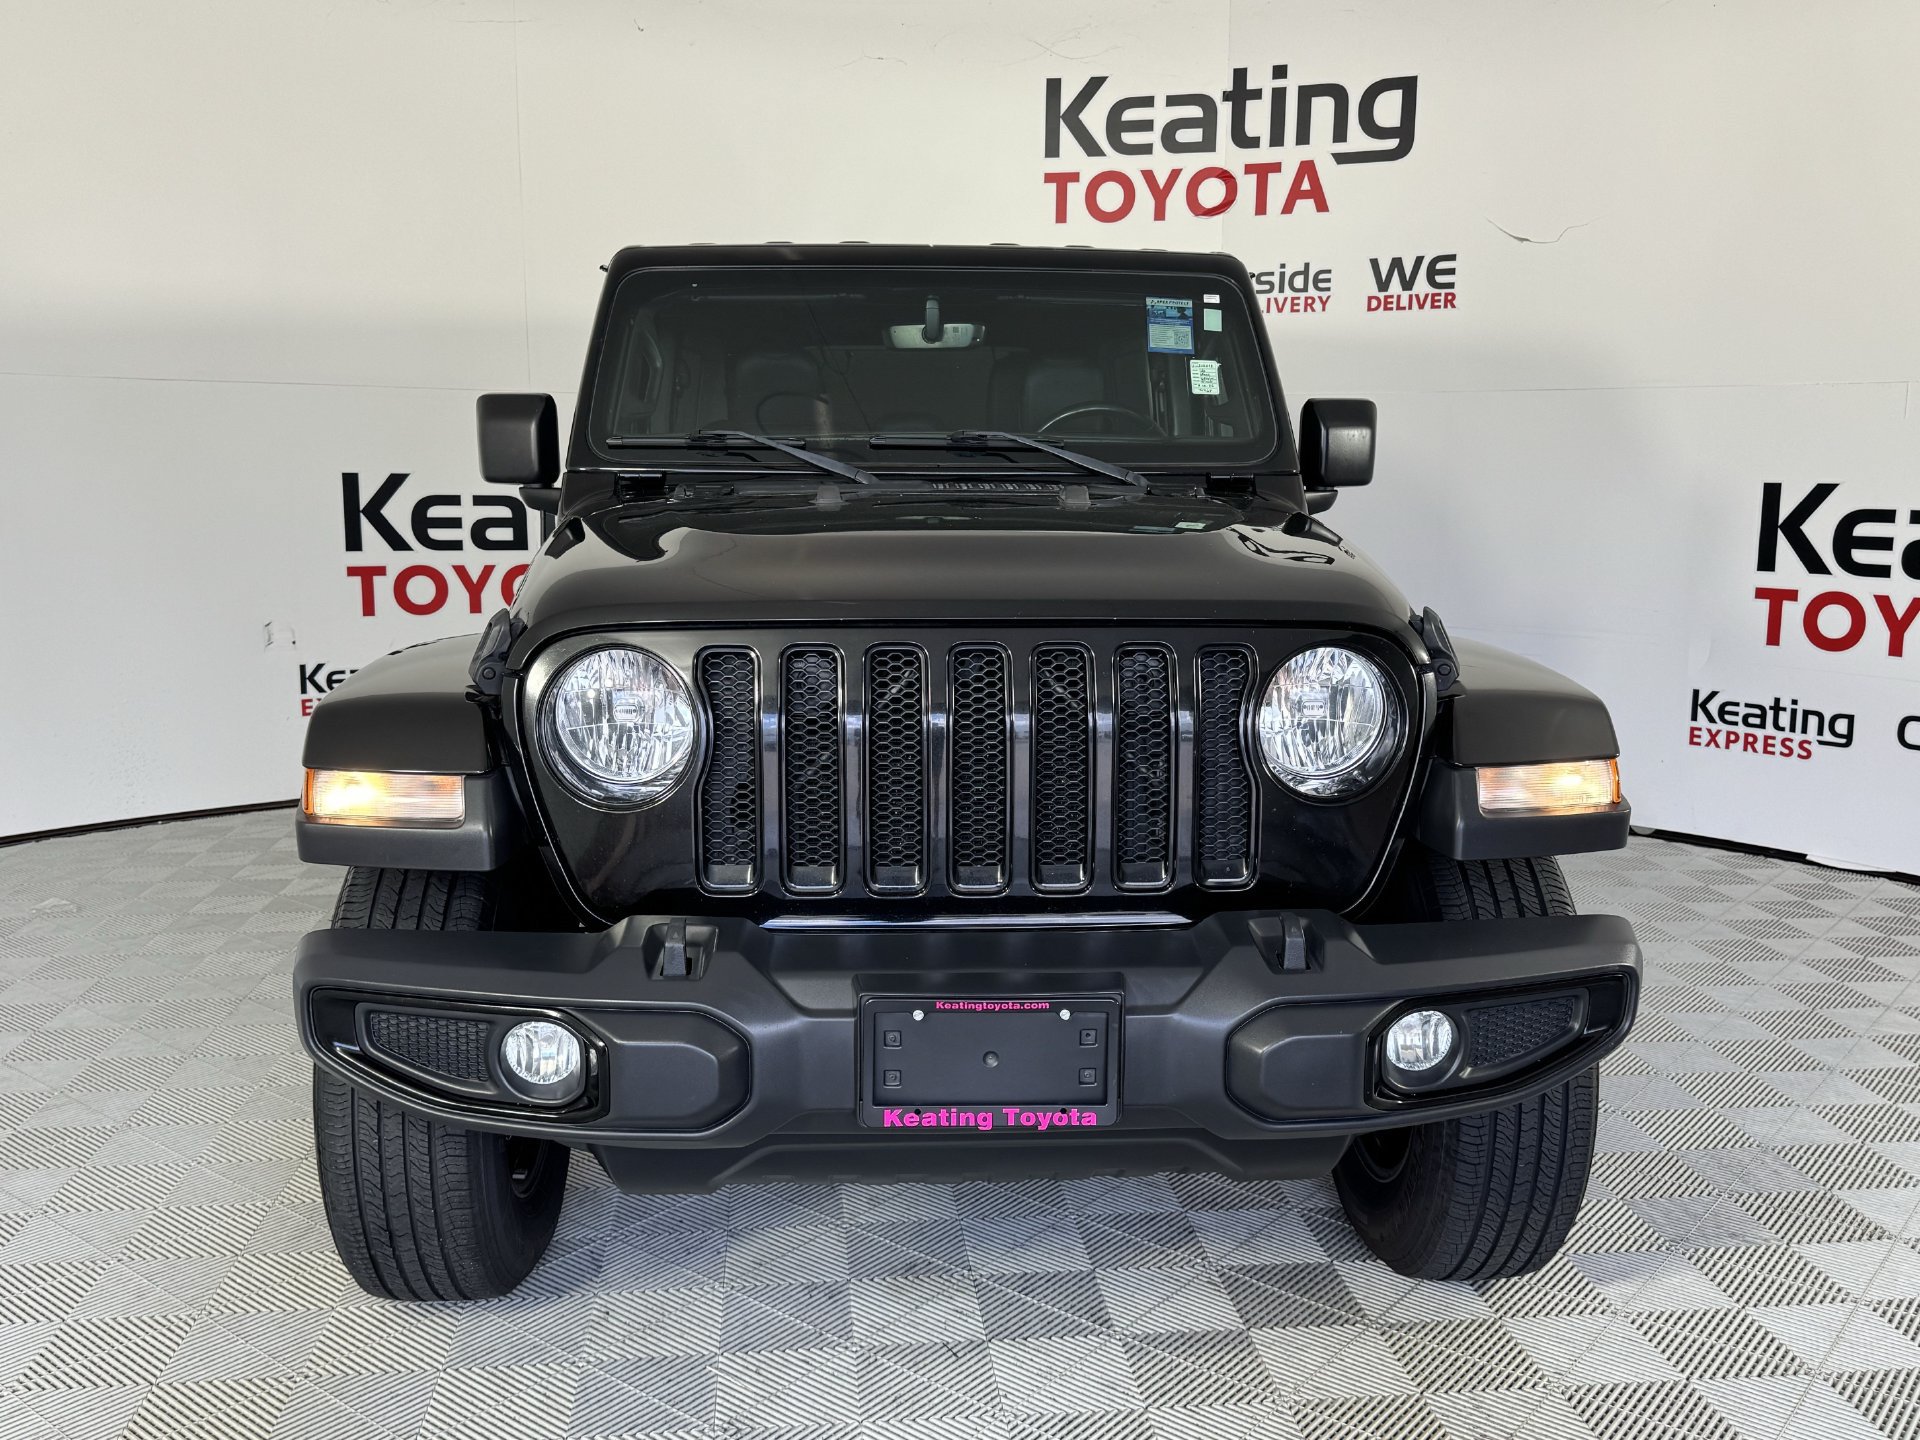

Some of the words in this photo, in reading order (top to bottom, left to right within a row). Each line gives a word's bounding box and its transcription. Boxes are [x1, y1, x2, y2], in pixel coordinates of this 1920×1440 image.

[1044, 64, 1418, 165] Keating
[1043, 159, 1330, 224] TOYOTA
[1255, 262, 1332, 294] side
[1368, 253, 1457, 292] WE
[1261, 295, 1331, 314] IVERY
[1366, 292, 1457, 313] DELIVER
[341, 472, 529, 552] Kea
[299, 663, 359, 695] Ke
[1690, 688, 1855, 748] Keating
[1688, 726, 1813, 760] EXPRESS
[935, 1001, 1050, 1012] Keatingtoyota.com
[883, 1108, 993, 1131] Keating
[1002, 1108, 1097, 1131] Toyota
